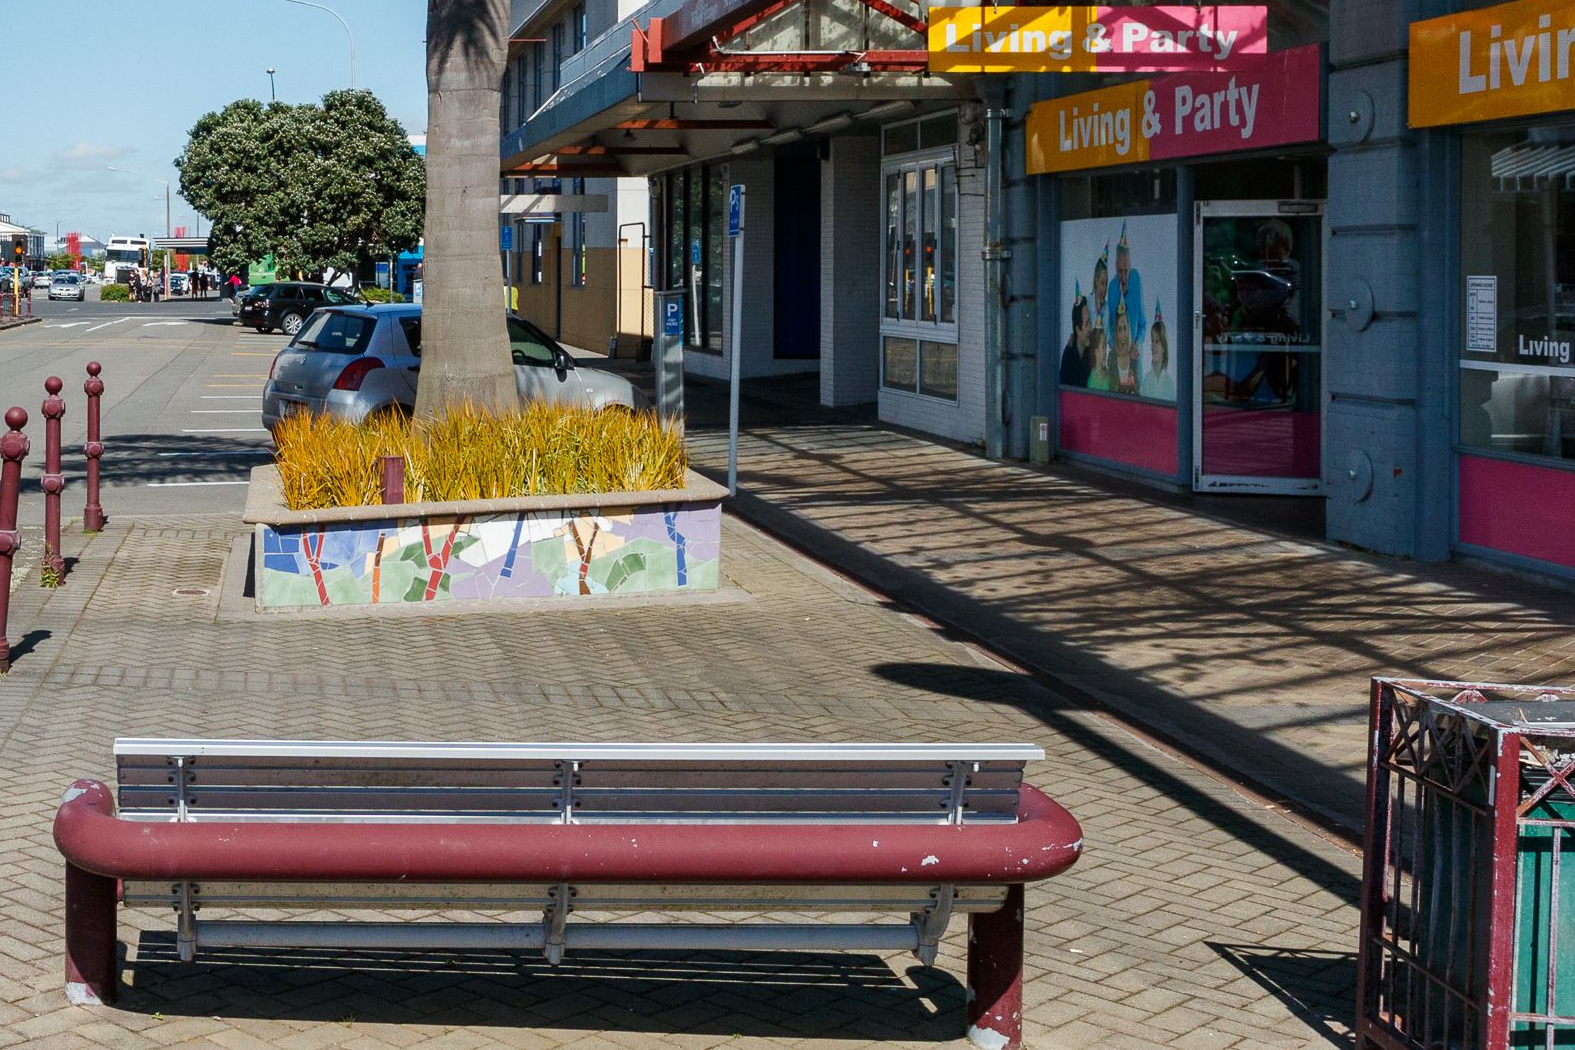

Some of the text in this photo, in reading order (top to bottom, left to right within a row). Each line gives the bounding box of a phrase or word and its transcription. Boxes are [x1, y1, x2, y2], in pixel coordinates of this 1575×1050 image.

[945, 21, 1239, 61] Living & Party
[1059, 76, 1261, 156] Living & Party
[667, 303, 678, 317] P
[1519, 334, 1570, 363] Living
